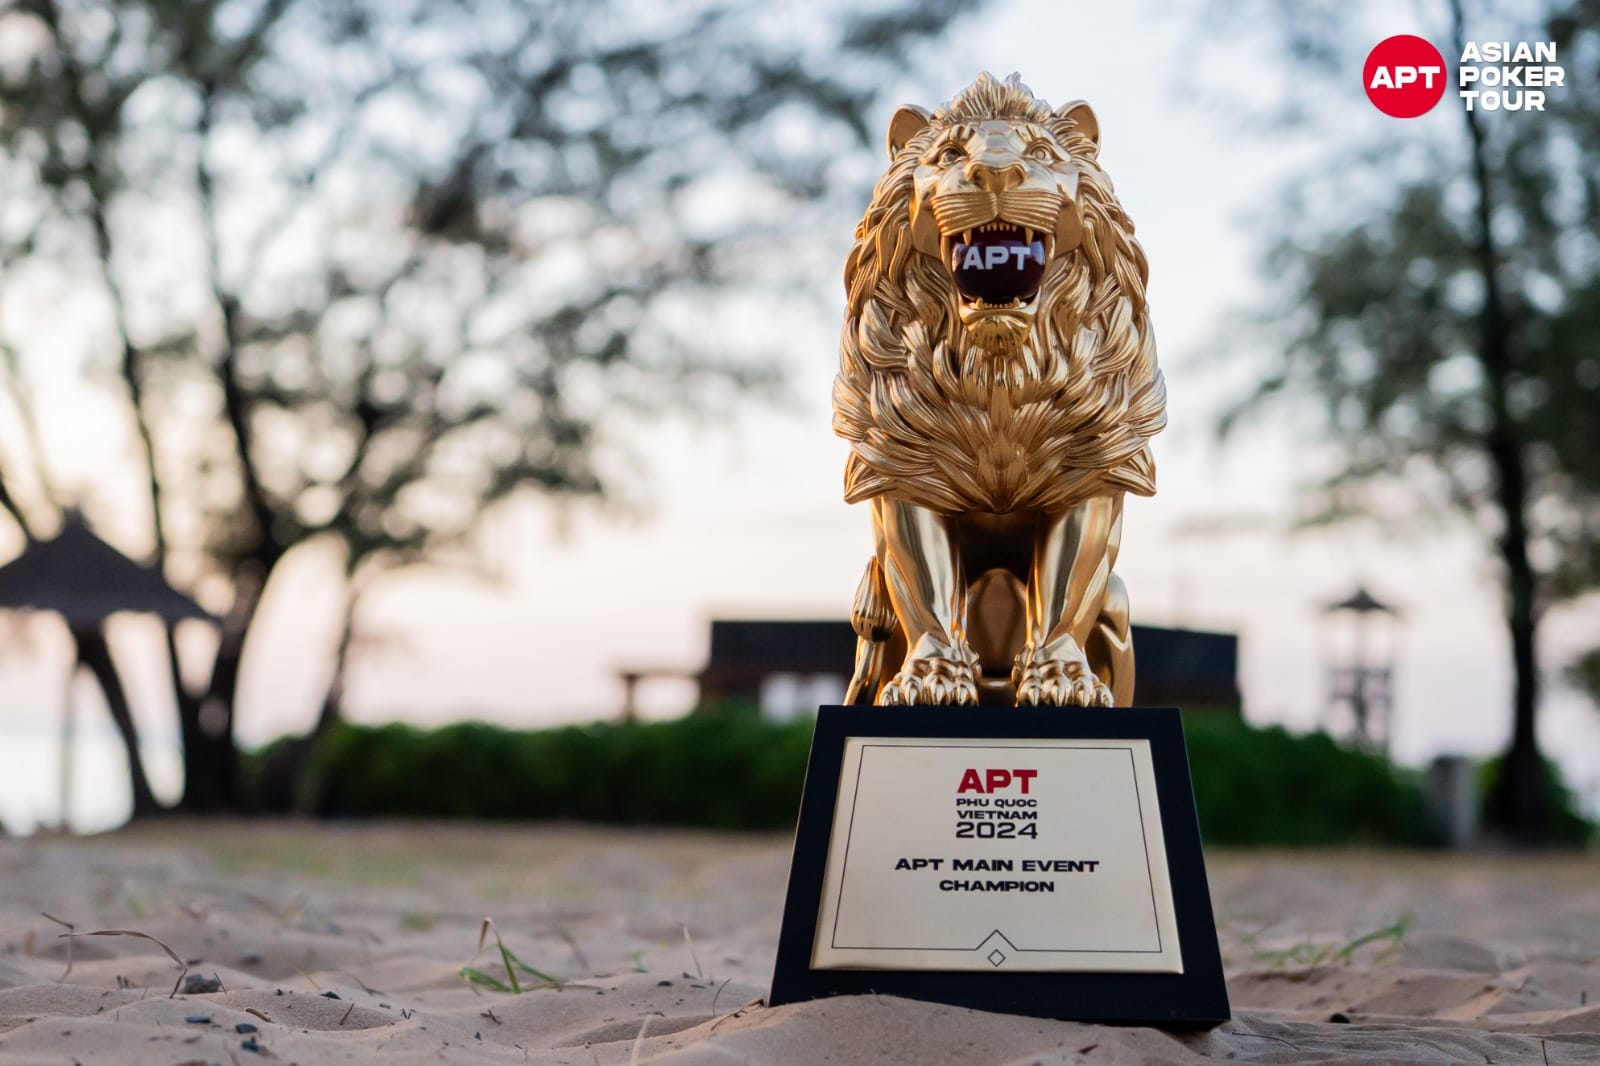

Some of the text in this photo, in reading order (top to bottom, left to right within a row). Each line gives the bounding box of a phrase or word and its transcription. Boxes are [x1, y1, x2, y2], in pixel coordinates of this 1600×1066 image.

[962, 246, 1031, 271] APT
[957, 768, 1038, 794] APT
[956, 798, 1038, 808] PHU QUOC
[956, 810, 1038, 820] VIETNAM
[956, 821, 1038, 839] 2024
[894, 858, 1099, 873] APT MAIN EVENT
[939, 880, 1055, 893] CHAMPION
